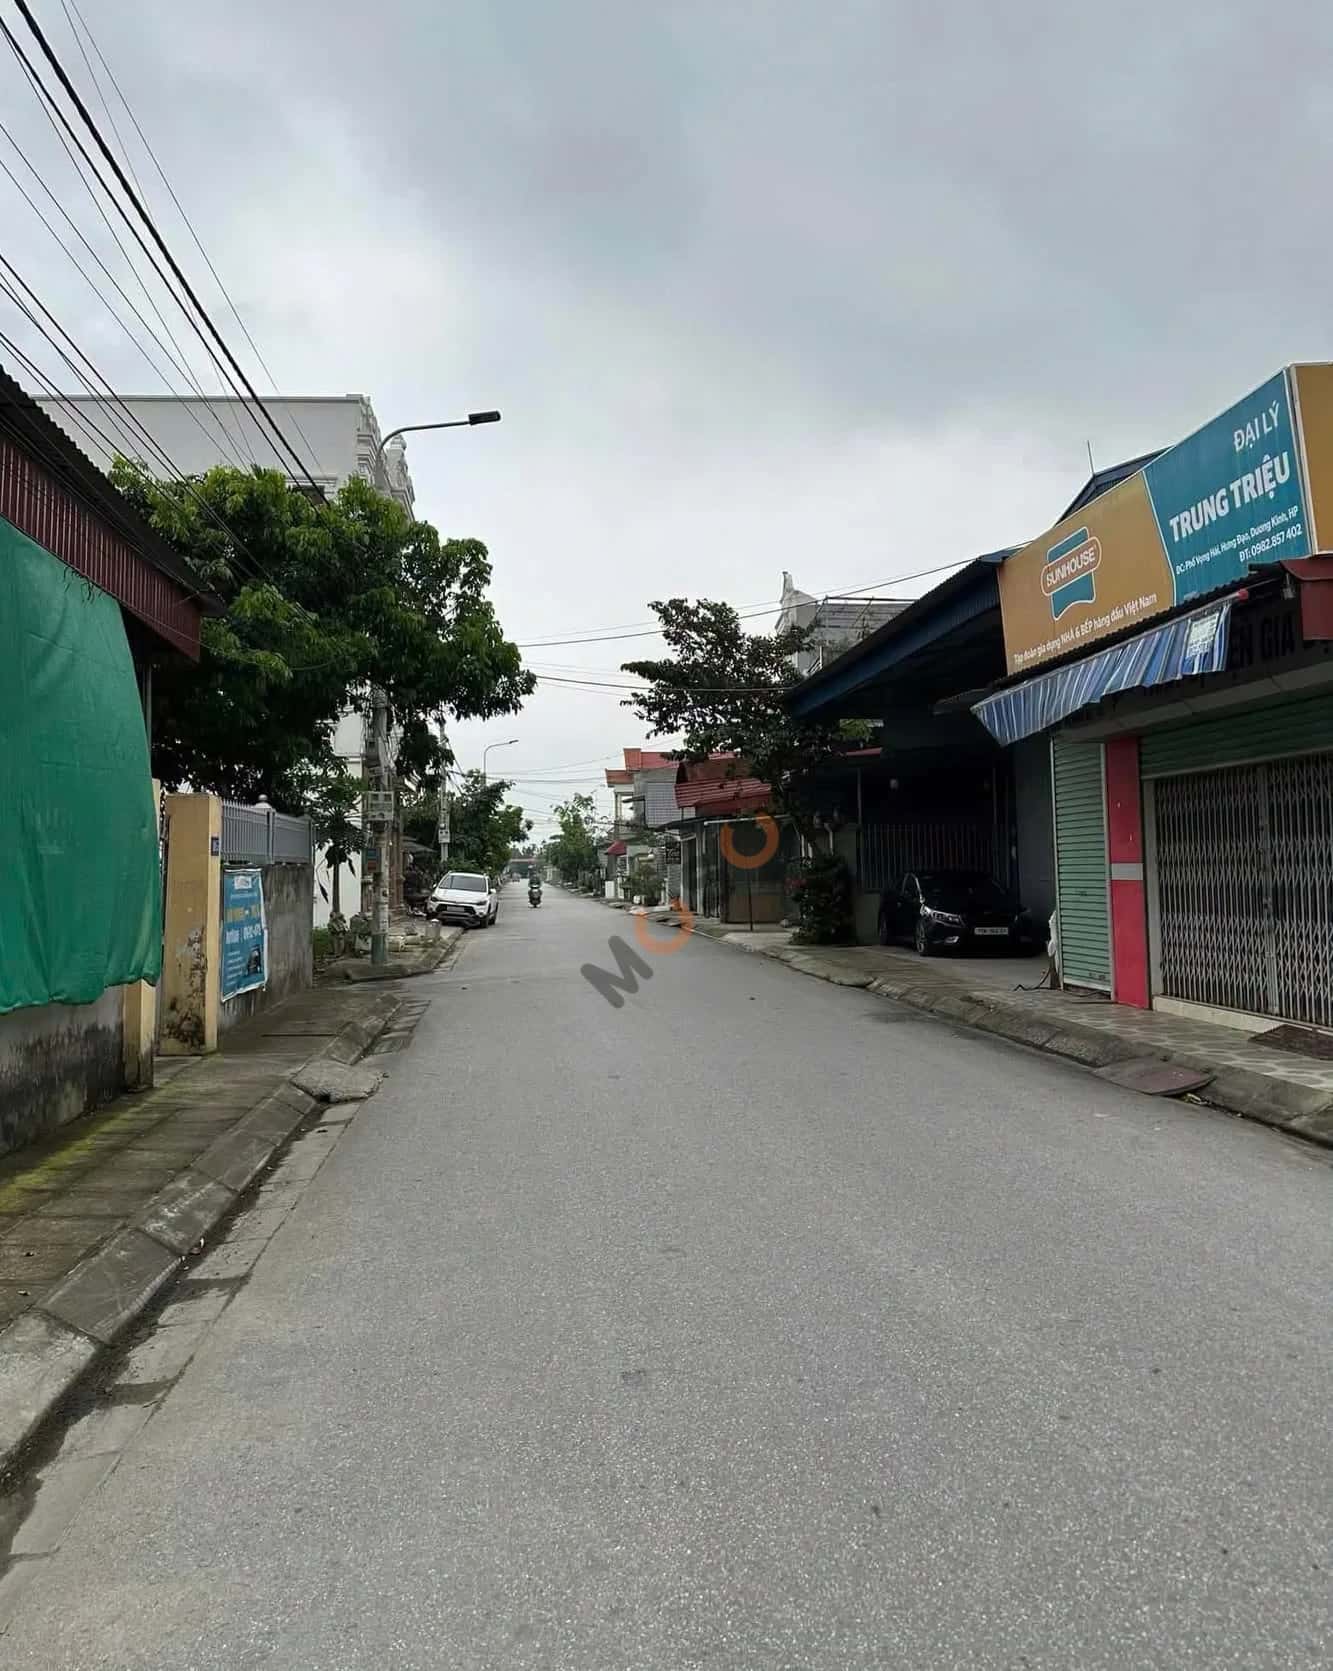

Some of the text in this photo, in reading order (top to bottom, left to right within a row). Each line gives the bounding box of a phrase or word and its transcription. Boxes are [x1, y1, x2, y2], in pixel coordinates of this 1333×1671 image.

[1233, 400, 1280, 453] ĐẠI LÝ
[1169, 451, 1290, 543] TRUNG TRIỆU
[1288, 505, 1298, 520] HP
[1046, 549, 1096, 588] SUNHOUSE
[1123, 598, 1139, 617] Việt
[1138, 592, 1157, 610] Nam
